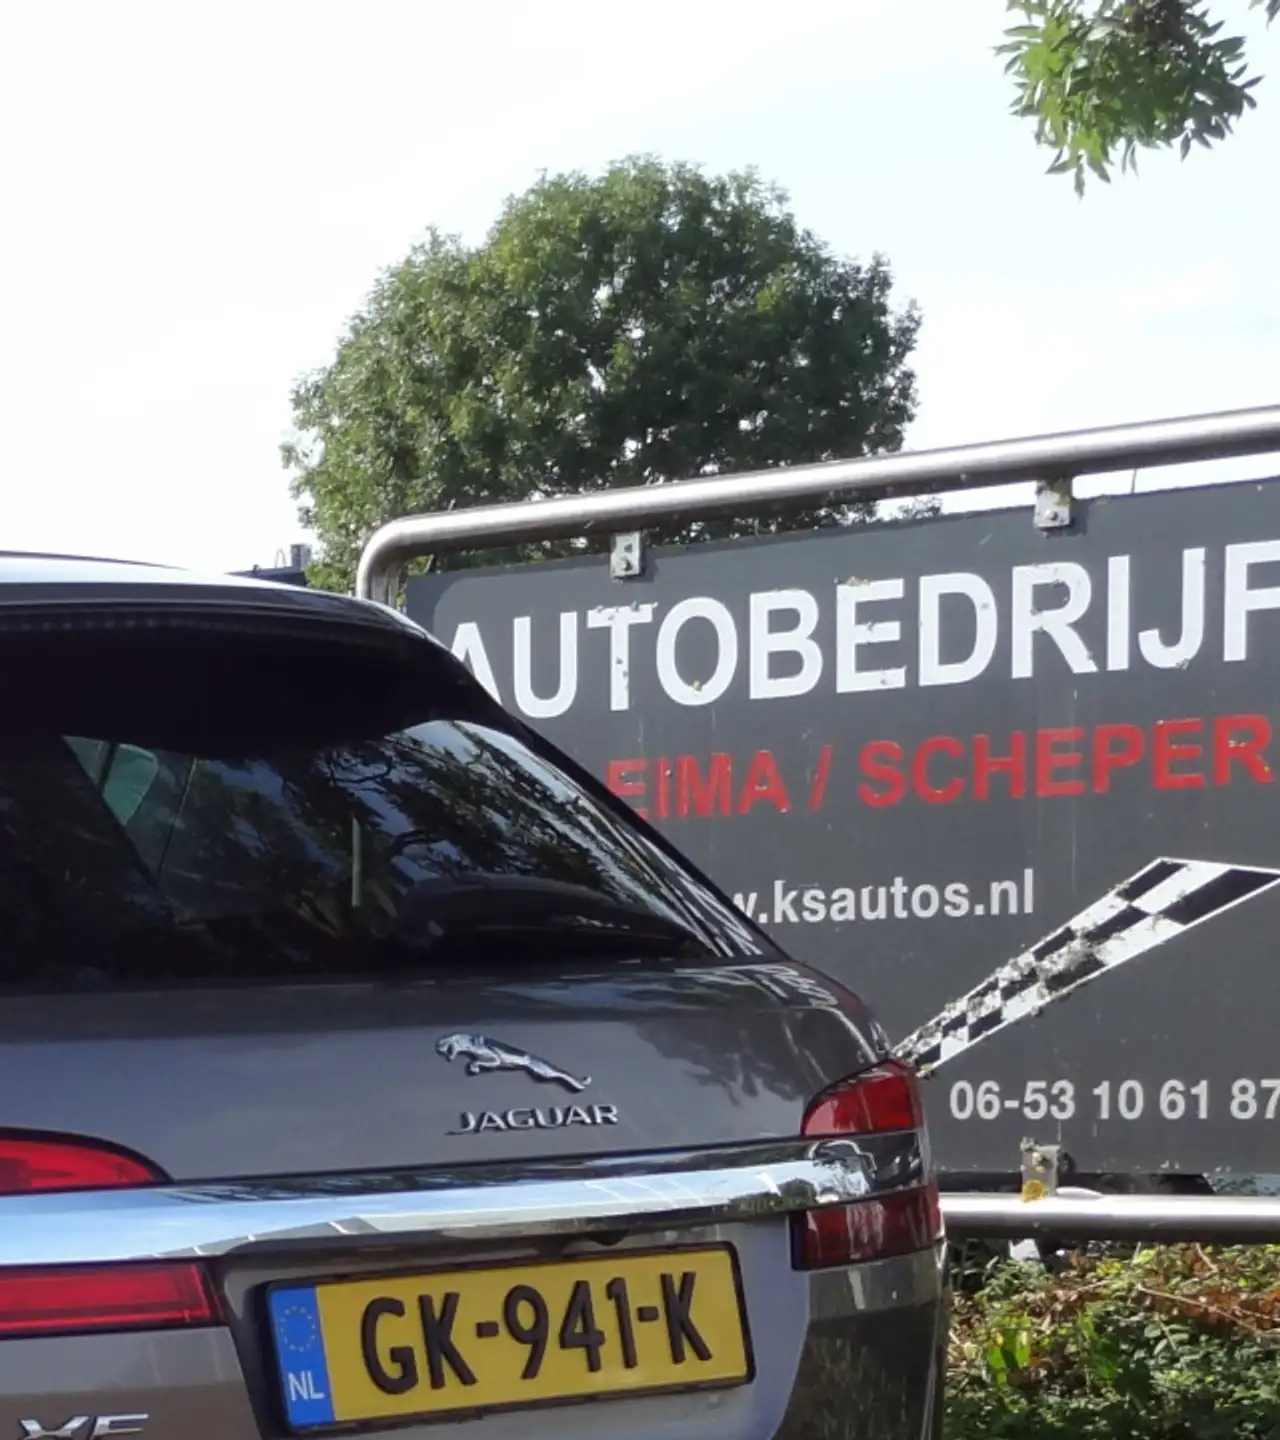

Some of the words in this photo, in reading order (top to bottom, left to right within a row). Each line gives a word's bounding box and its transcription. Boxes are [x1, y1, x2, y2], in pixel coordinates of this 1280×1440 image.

[857, 713, 1275, 809] SCHEPER
[446, 1103, 619, 1135] JAGUAR
[950, 1079, 1076, 1120] 06-53
[1092, 1079, 1144, 1120] 10
[1159, 1078, 1209, 1120] 61
[1230, 1078, 1280, 1120] 87
[360, 1267, 713, 1395] GK-941-K
[287, 1370, 325, 1402] NL
